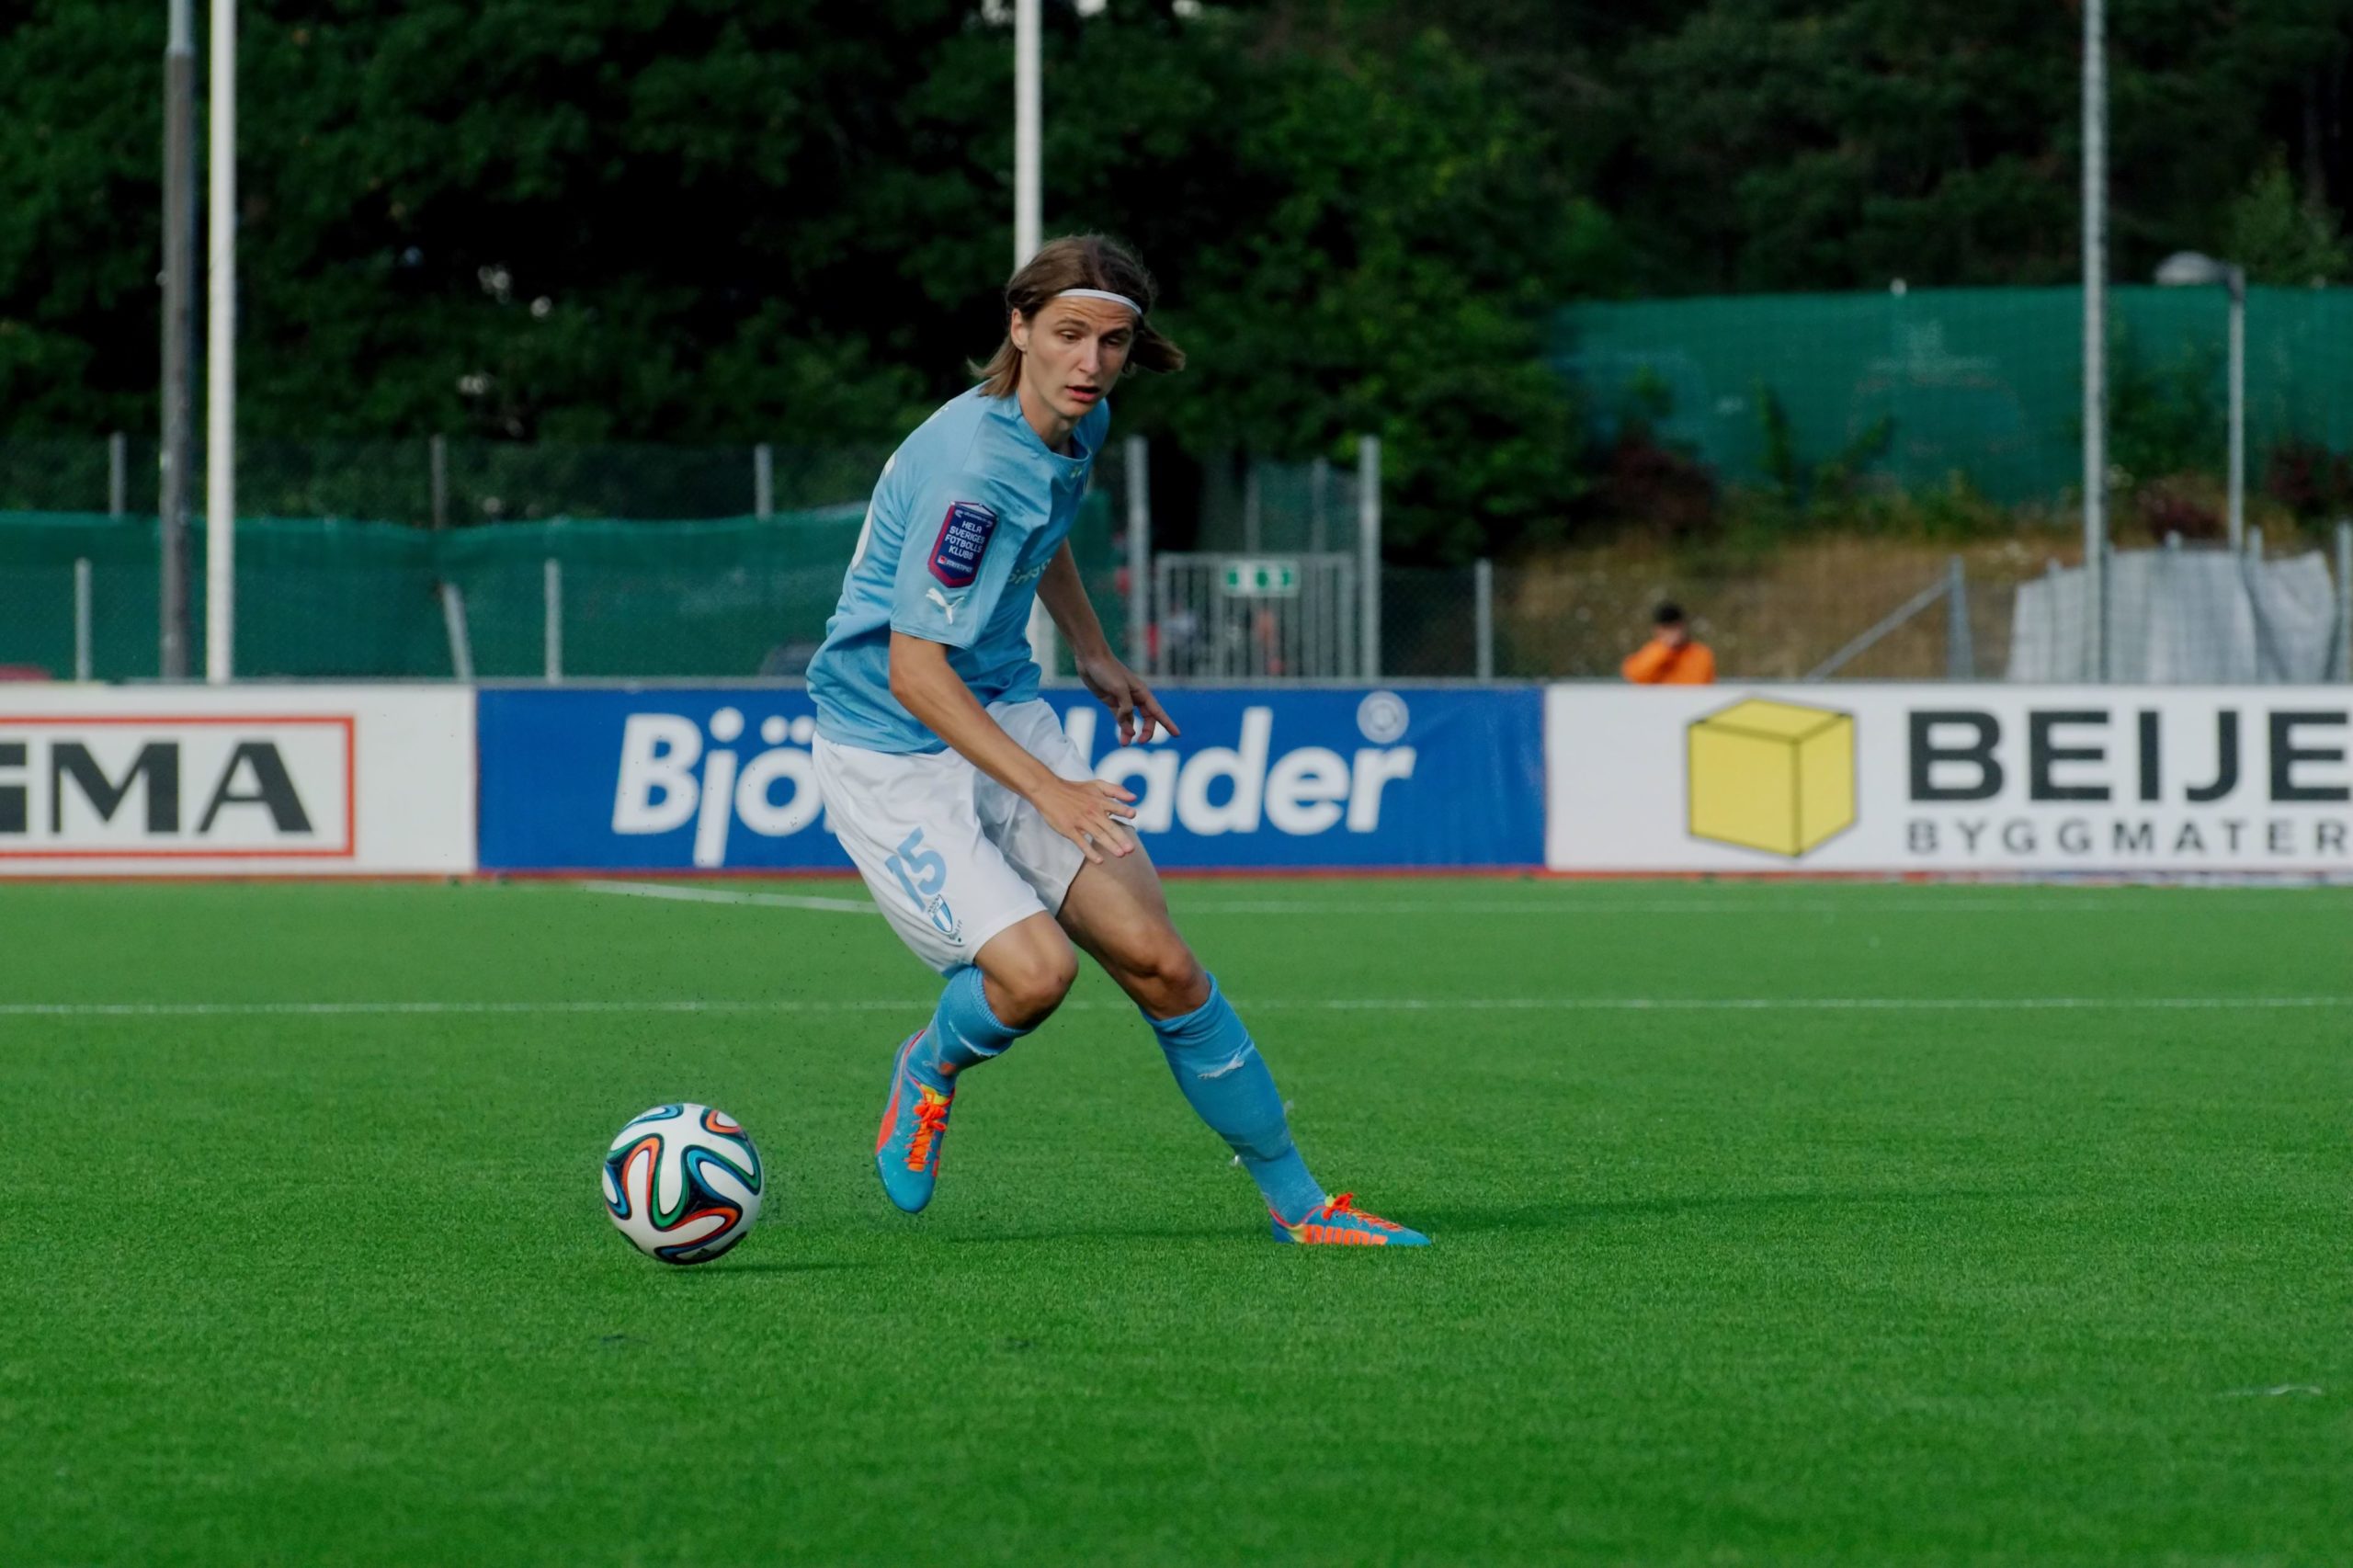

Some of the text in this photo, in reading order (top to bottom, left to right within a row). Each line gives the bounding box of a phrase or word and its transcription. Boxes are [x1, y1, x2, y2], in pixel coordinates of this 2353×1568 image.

[949, 526, 985, 544] SVERIGES
[961, 521, 983, 533] HELA
[945, 534, 983, 553] FOTBOLLS
[949, 545, 974, 560] KLUBB
[1908, 710, 2350, 801] BEIJE
[0, 741, 313, 834] MA
[1907, 819, 2347, 856] BYGGMATER
[885, 826, 947, 914] 15
